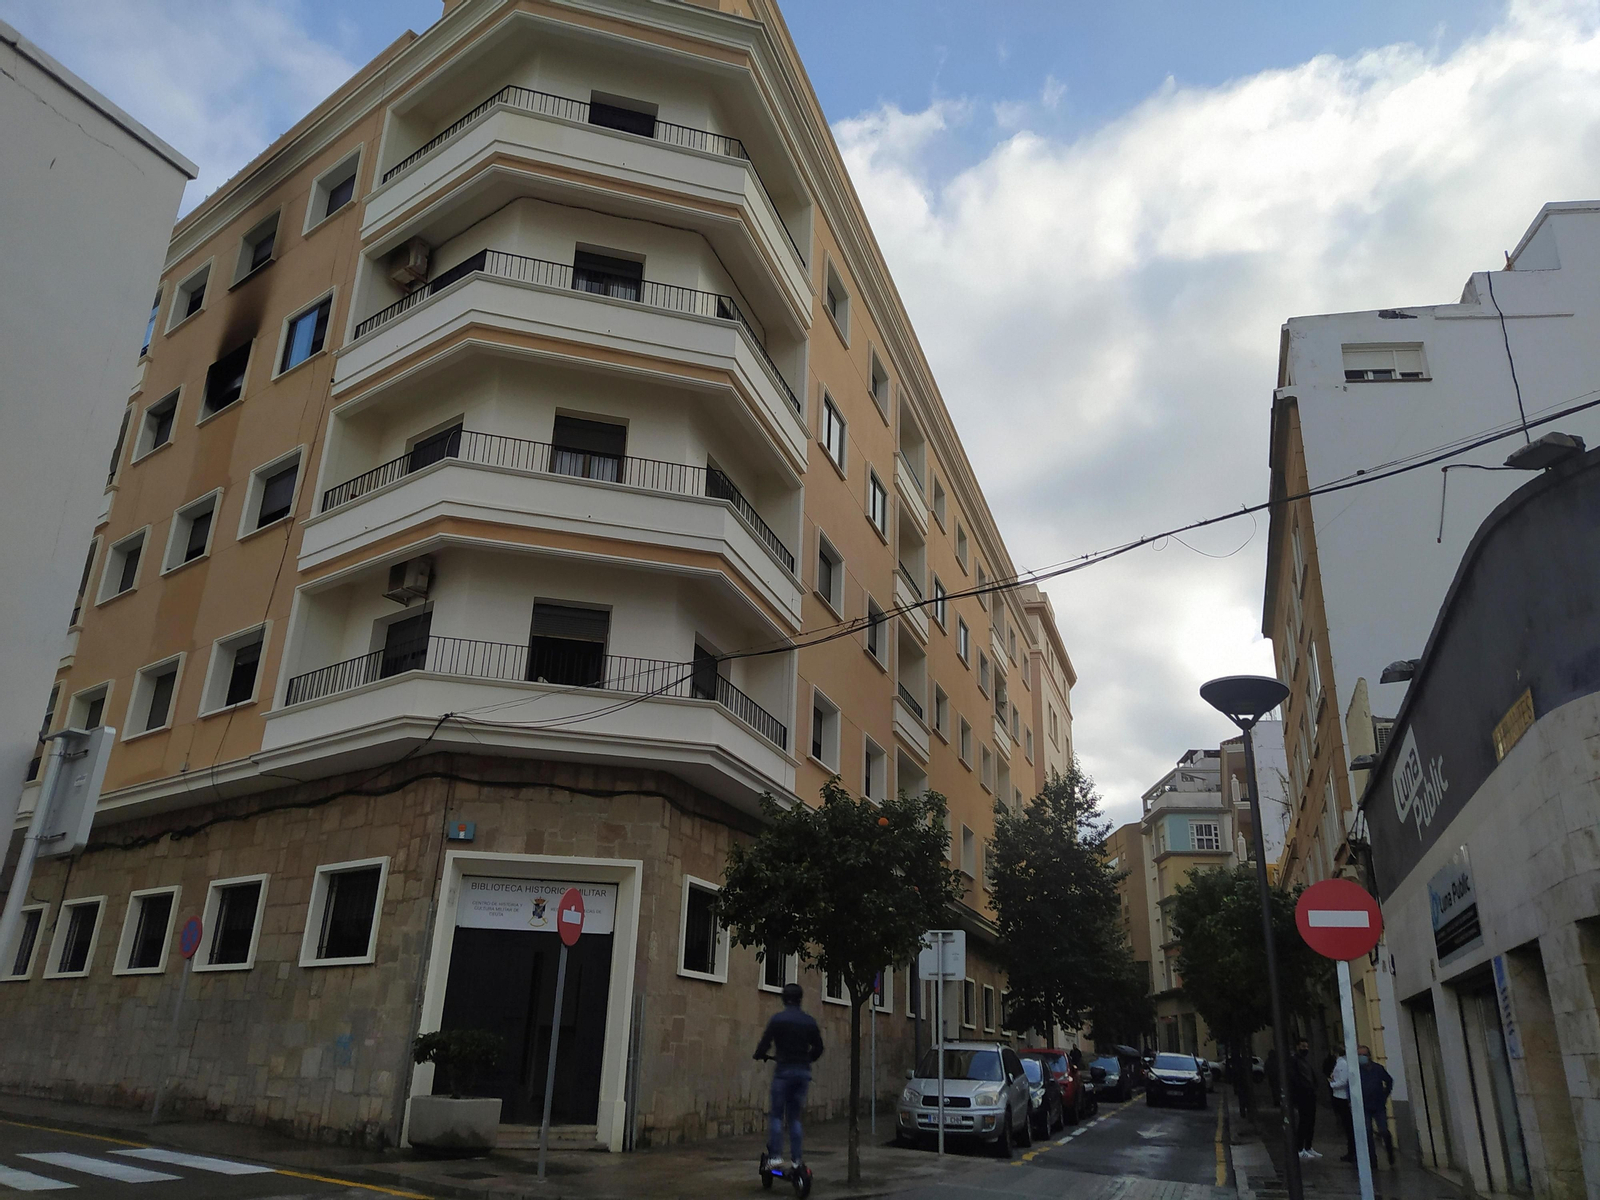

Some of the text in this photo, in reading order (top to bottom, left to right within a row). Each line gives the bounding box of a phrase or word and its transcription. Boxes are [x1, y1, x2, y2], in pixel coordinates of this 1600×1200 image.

[1394, 747, 1420, 811] Luna
[1412, 755, 1449, 842] Public
[471, 882, 523, 893] BIBLIOTECA
[525, 885, 569, 895] HISTORIC
